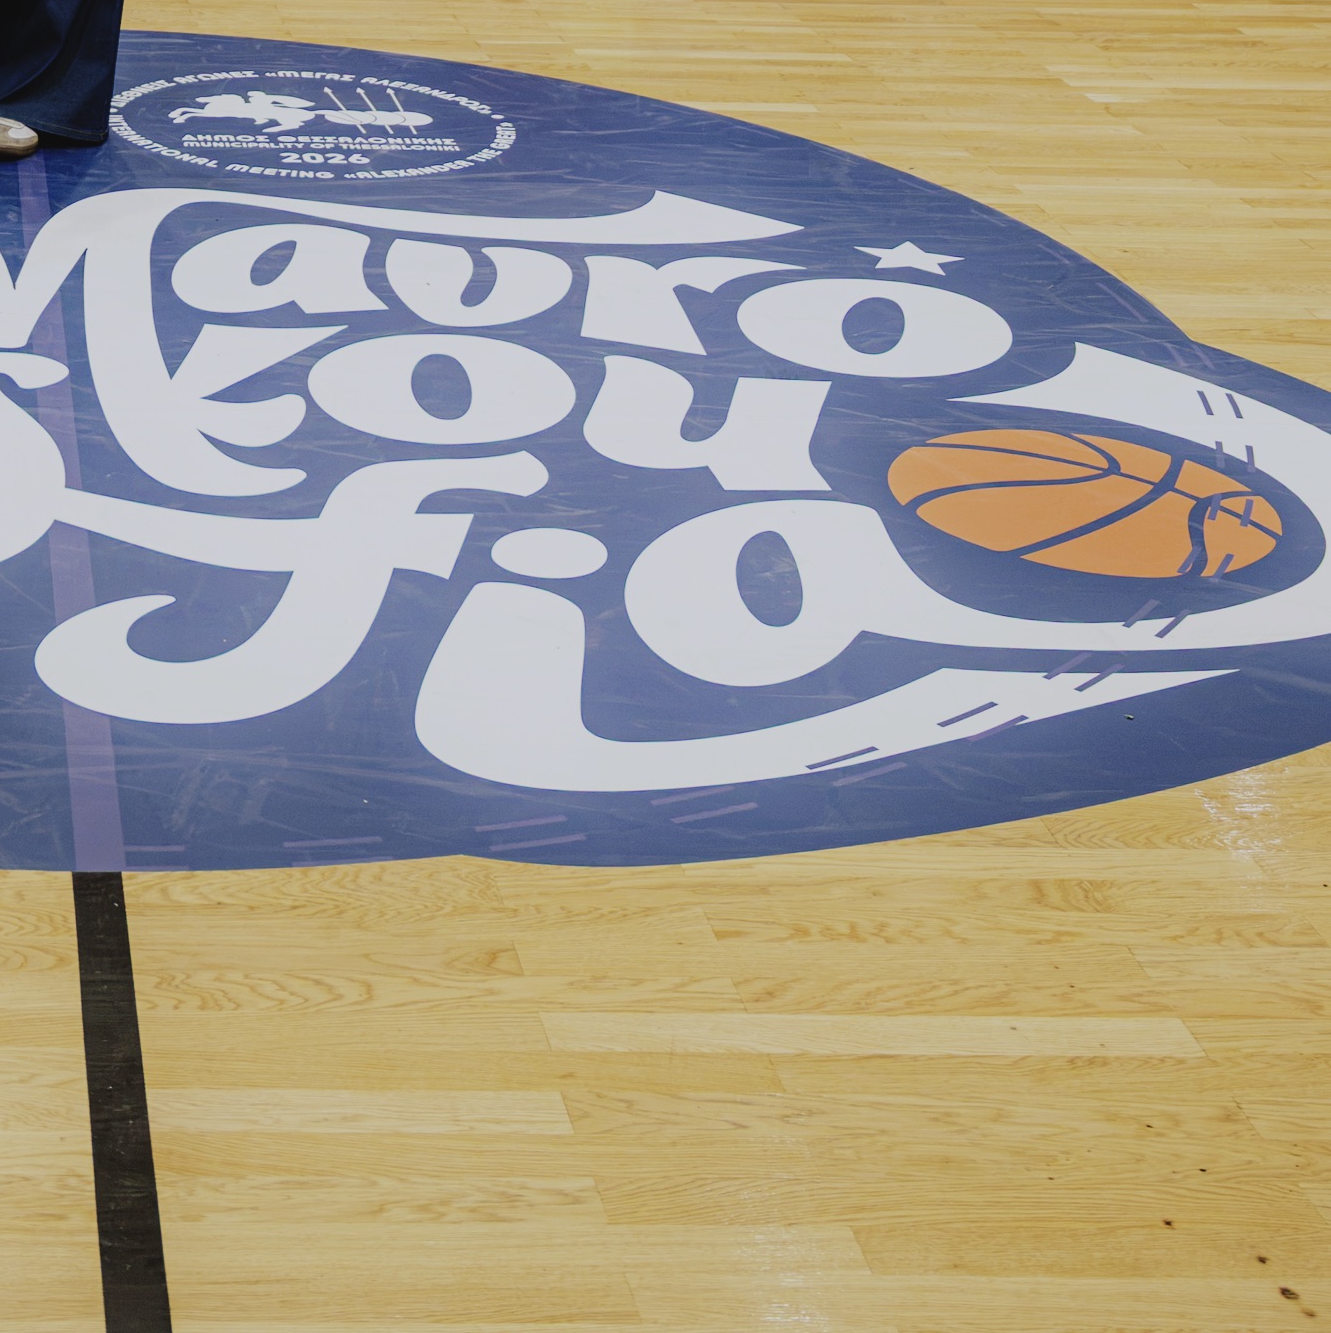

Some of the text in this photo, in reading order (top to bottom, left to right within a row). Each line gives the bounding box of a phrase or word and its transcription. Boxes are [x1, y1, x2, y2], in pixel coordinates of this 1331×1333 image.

[183, 141, 305, 149] MUNICIPALITY
[338, 143, 461, 153] THESSALONIKI
[225, 163, 335, 179] MEETING
[466, 148, 503, 163] THE
[279, 151, 371, 165] 2026
